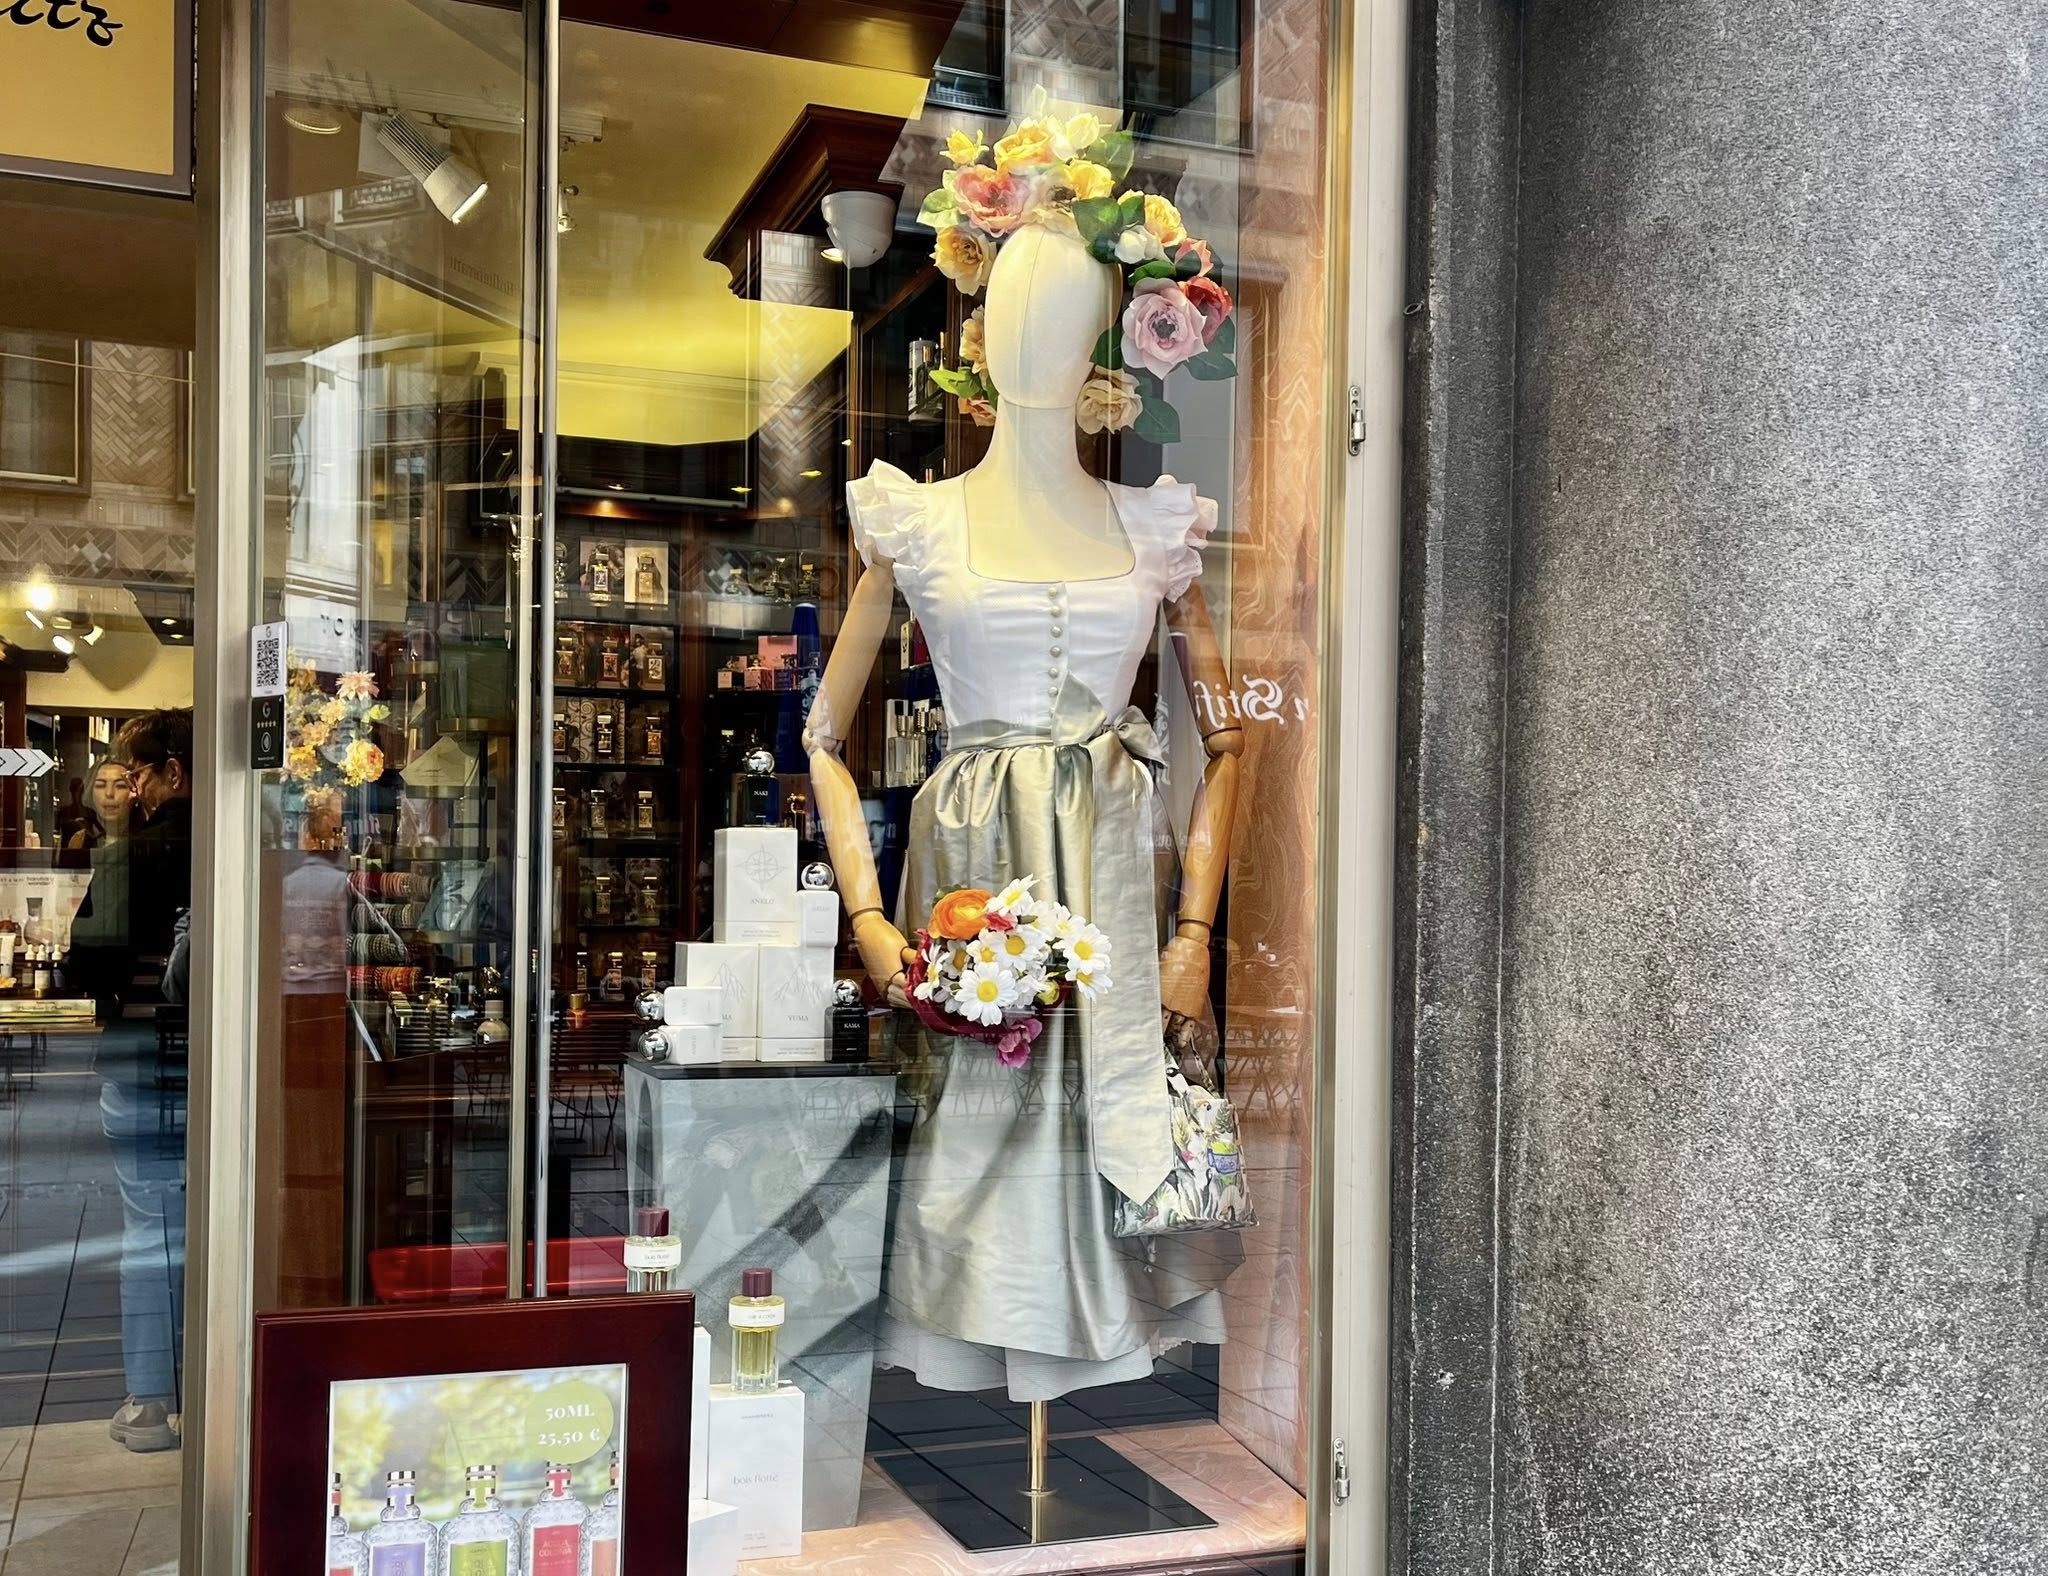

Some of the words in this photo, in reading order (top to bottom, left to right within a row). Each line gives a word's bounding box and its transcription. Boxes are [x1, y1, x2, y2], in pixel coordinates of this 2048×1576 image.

[545, 1404, 595, 1422] 50ML
[537, 1431, 584, 1447] 25,50
[589, 1428, 600, 1441] €
[733, 1474, 753, 1485] bois
